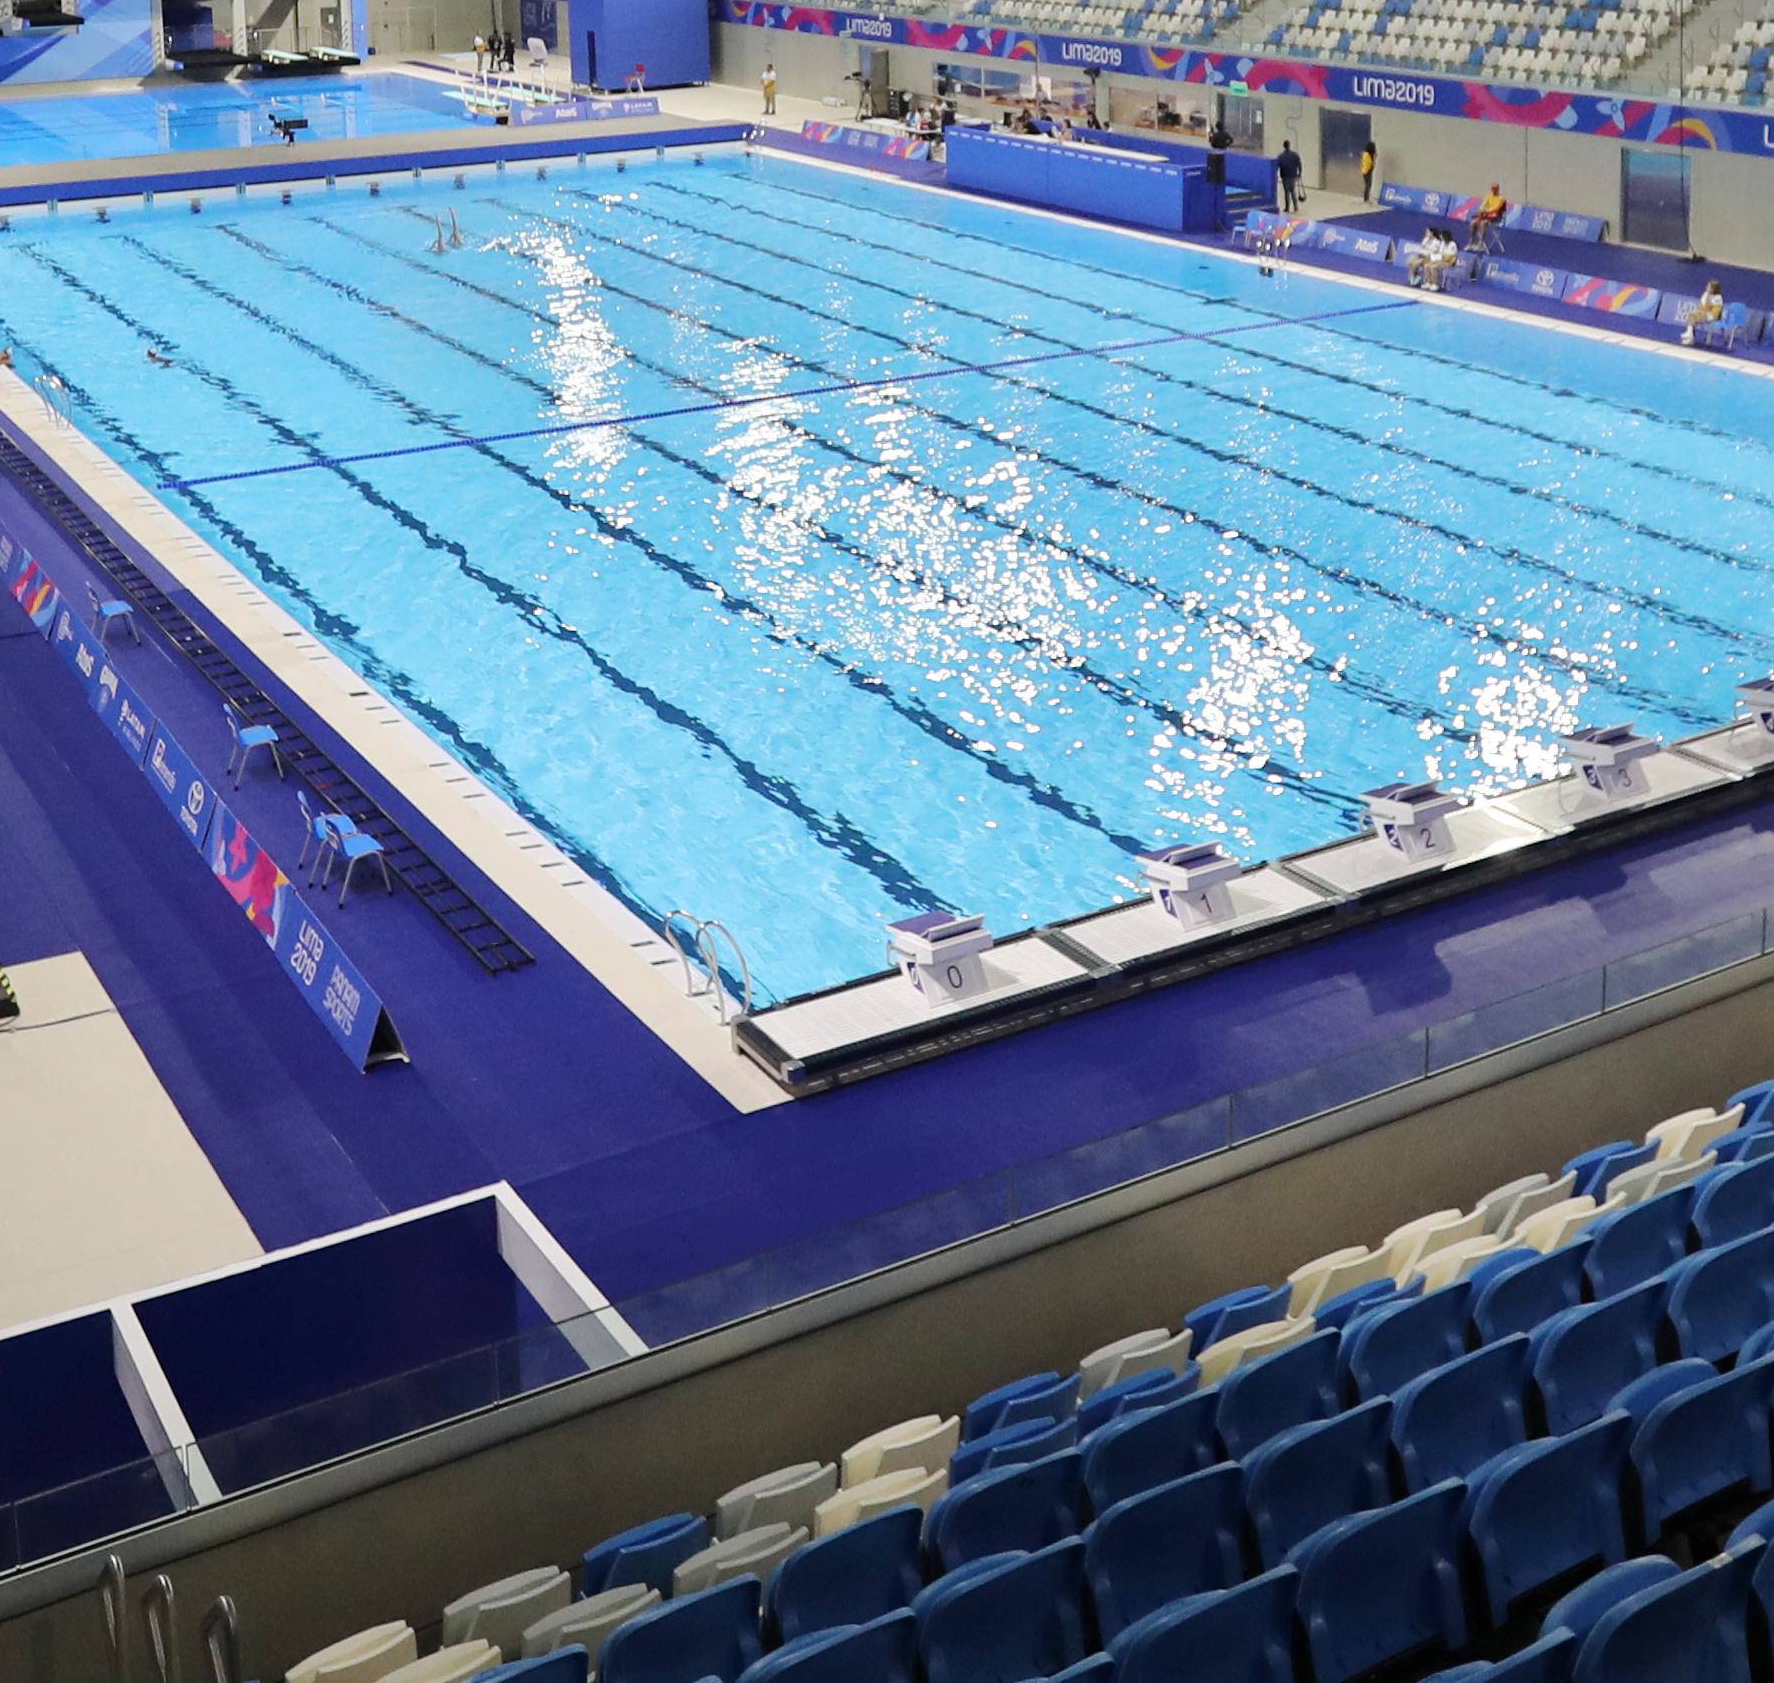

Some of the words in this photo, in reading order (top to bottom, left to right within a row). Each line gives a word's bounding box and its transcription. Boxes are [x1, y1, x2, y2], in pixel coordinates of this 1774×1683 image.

[1618, 768, 1632, 788] 3
[1420, 828, 1436, 849] 2
[1200, 893, 1213, 914] 1
[290, 941, 318, 986] 2019
[947, 965, 963, 989] 0
